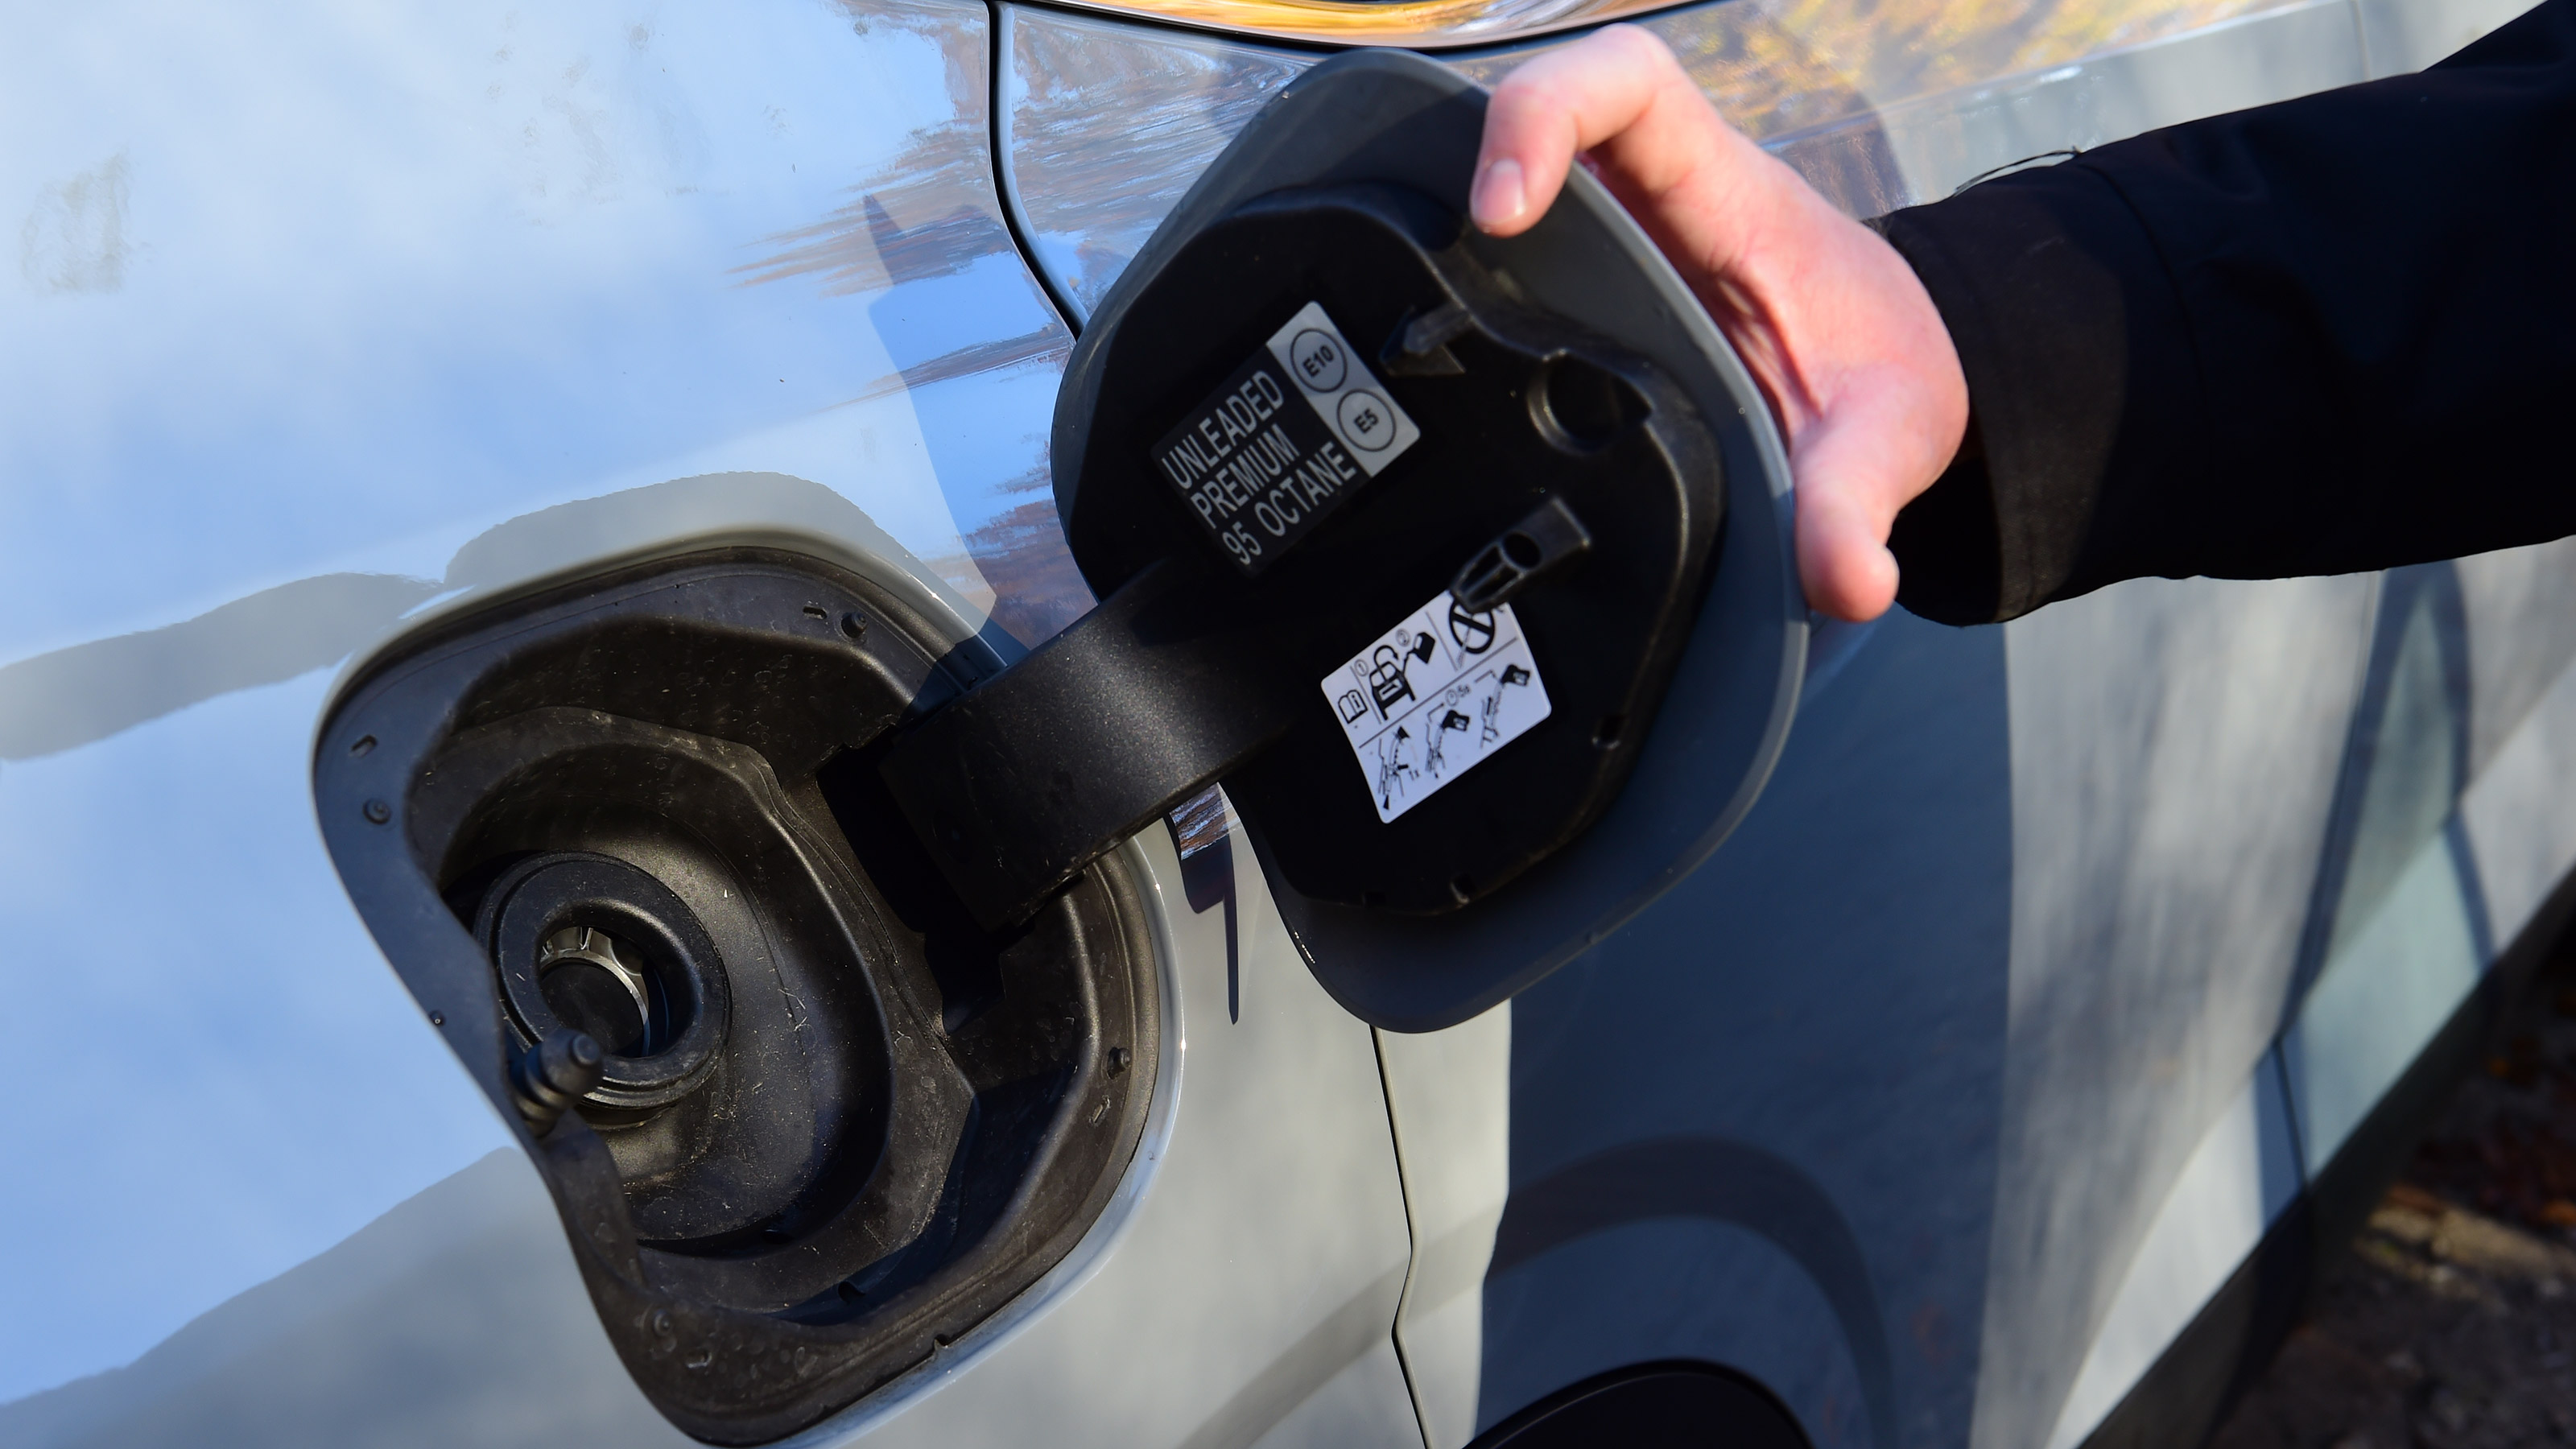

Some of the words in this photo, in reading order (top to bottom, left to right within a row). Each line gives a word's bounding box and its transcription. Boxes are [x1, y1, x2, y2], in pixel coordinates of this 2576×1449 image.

[1302, 345, 1334, 378] E10
[1161, 370, 1285, 489] UNLEADED
[1353, 408, 1380, 434] E5
[1191, 423, 1300, 530] PREMIUM
[1222, 521, 1262, 565] 95
[1254, 442, 1357, 537] OCTANE
